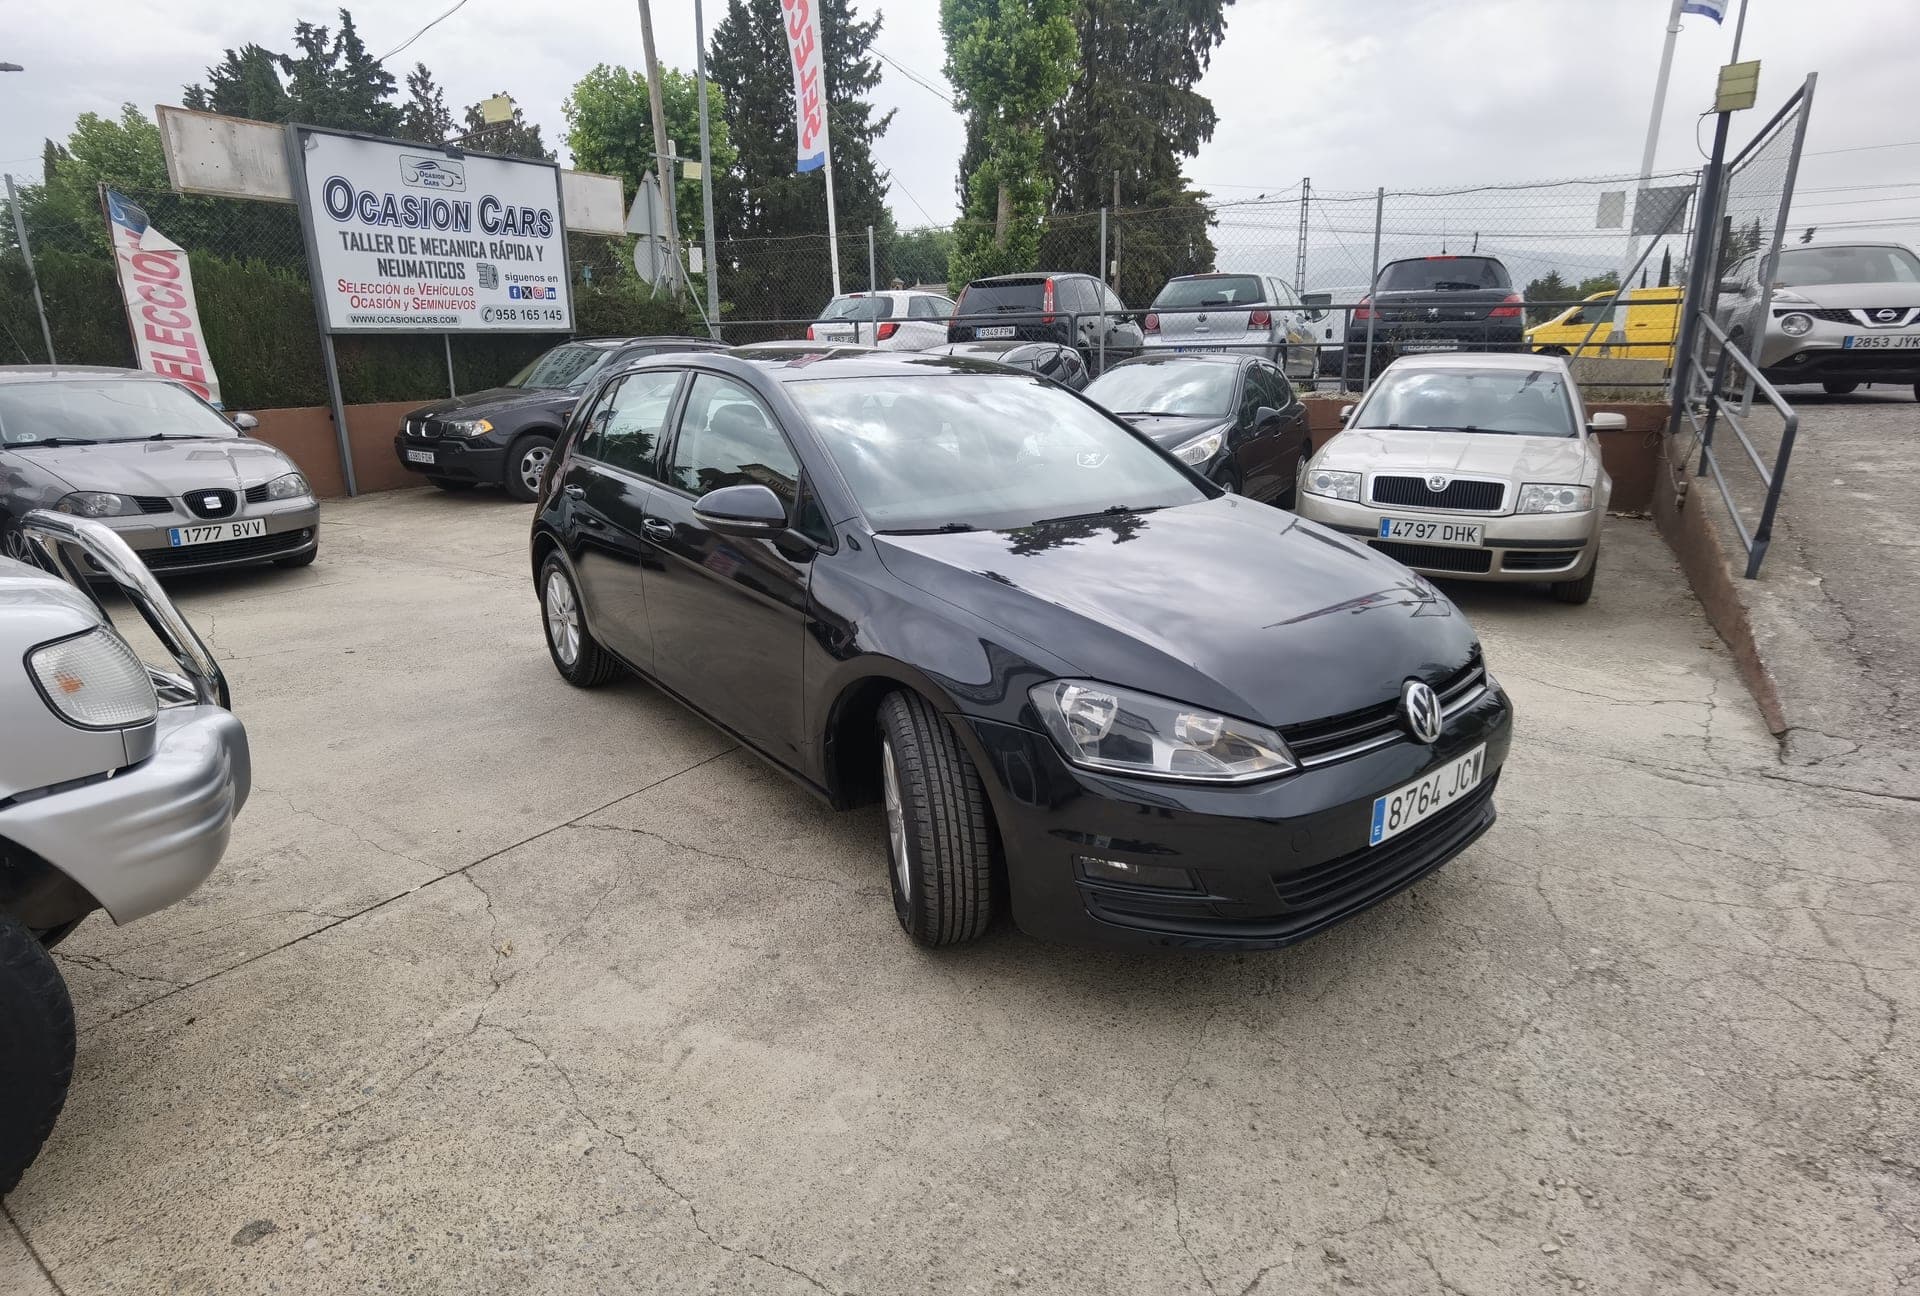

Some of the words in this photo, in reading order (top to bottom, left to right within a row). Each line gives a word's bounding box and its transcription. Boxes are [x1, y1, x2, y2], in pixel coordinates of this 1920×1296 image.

[419, 170, 445, 180] OCASION
[423, 178, 440, 187] CARS
[322, 175, 472, 233] OCASION
[477, 194, 554, 239] CARS
[338, 230, 396, 254] TALLER
[397, 235, 418, 255] DE
[420, 236, 488, 259] MECANICA
[489, 239, 535, 262] RÁPIDA
[535, 244, 544, 262] Y
[376, 257, 467, 280] NEUMATICOS
[337, 278, 401, 295] SELECCIÓN
[403, 285, 416, 295] de
[418, 282, 475, 297] VEHÍCULOS
[547, 275, 559, 283] en
[350, 295, 401, 309] OCASIÓN
[403, 301, 410, 312] y
[412, 297, 477, 311] SEMINUEVOS
[350, 314, 459, 325] WWW.OCASIONCARS.COM
[495, 308, 517, 320] 958
[520, 309, 540, 321] 165
[543, 309, 563, 321] 145
[1853, 337, 1890, 348] 2853
[1894, 336, 1920, 348] JYK
[183, 525, 223, 543] 1777
[231, 520, 261, 538] BVV
[1392, 521, 1438, 539] 4797
[1442, 524, 1478, 543] DHK
[1388, 774, 1442, 831] 8764
[1448, 749, 1483, 798] JCW
